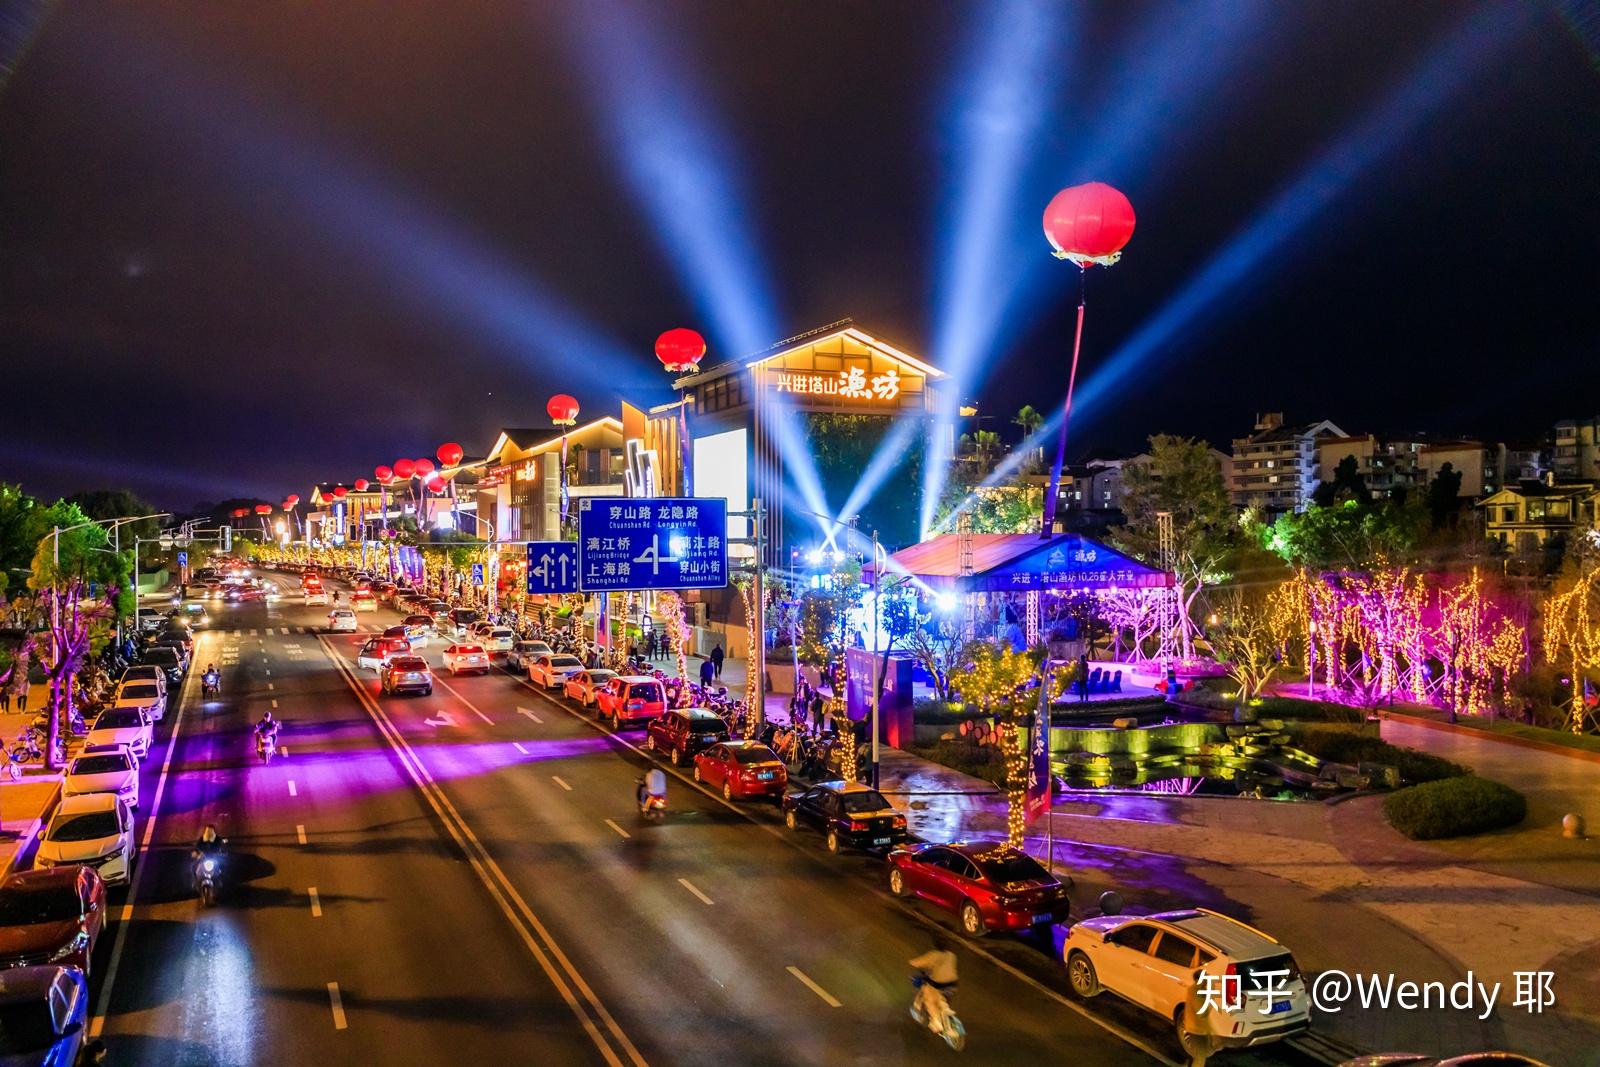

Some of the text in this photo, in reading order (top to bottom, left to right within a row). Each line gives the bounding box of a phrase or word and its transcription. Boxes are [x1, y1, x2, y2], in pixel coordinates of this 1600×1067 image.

[609, 506, 699, 520] 穿山路 龙隐路
[609, 521, 642, 529] Chuanshan
[657, 521, 687, 529] Longyin
[587, 537, 631, 551] 漓江桥
[588, 552, 630, 560] Lijiang Bridge
[587, 562, 631, 577] 上海路
[680, 560, 720, 574] 穿山小街
[587, 577, 619, 586] Shanghai
[708, 574, 720, 582] Alley
